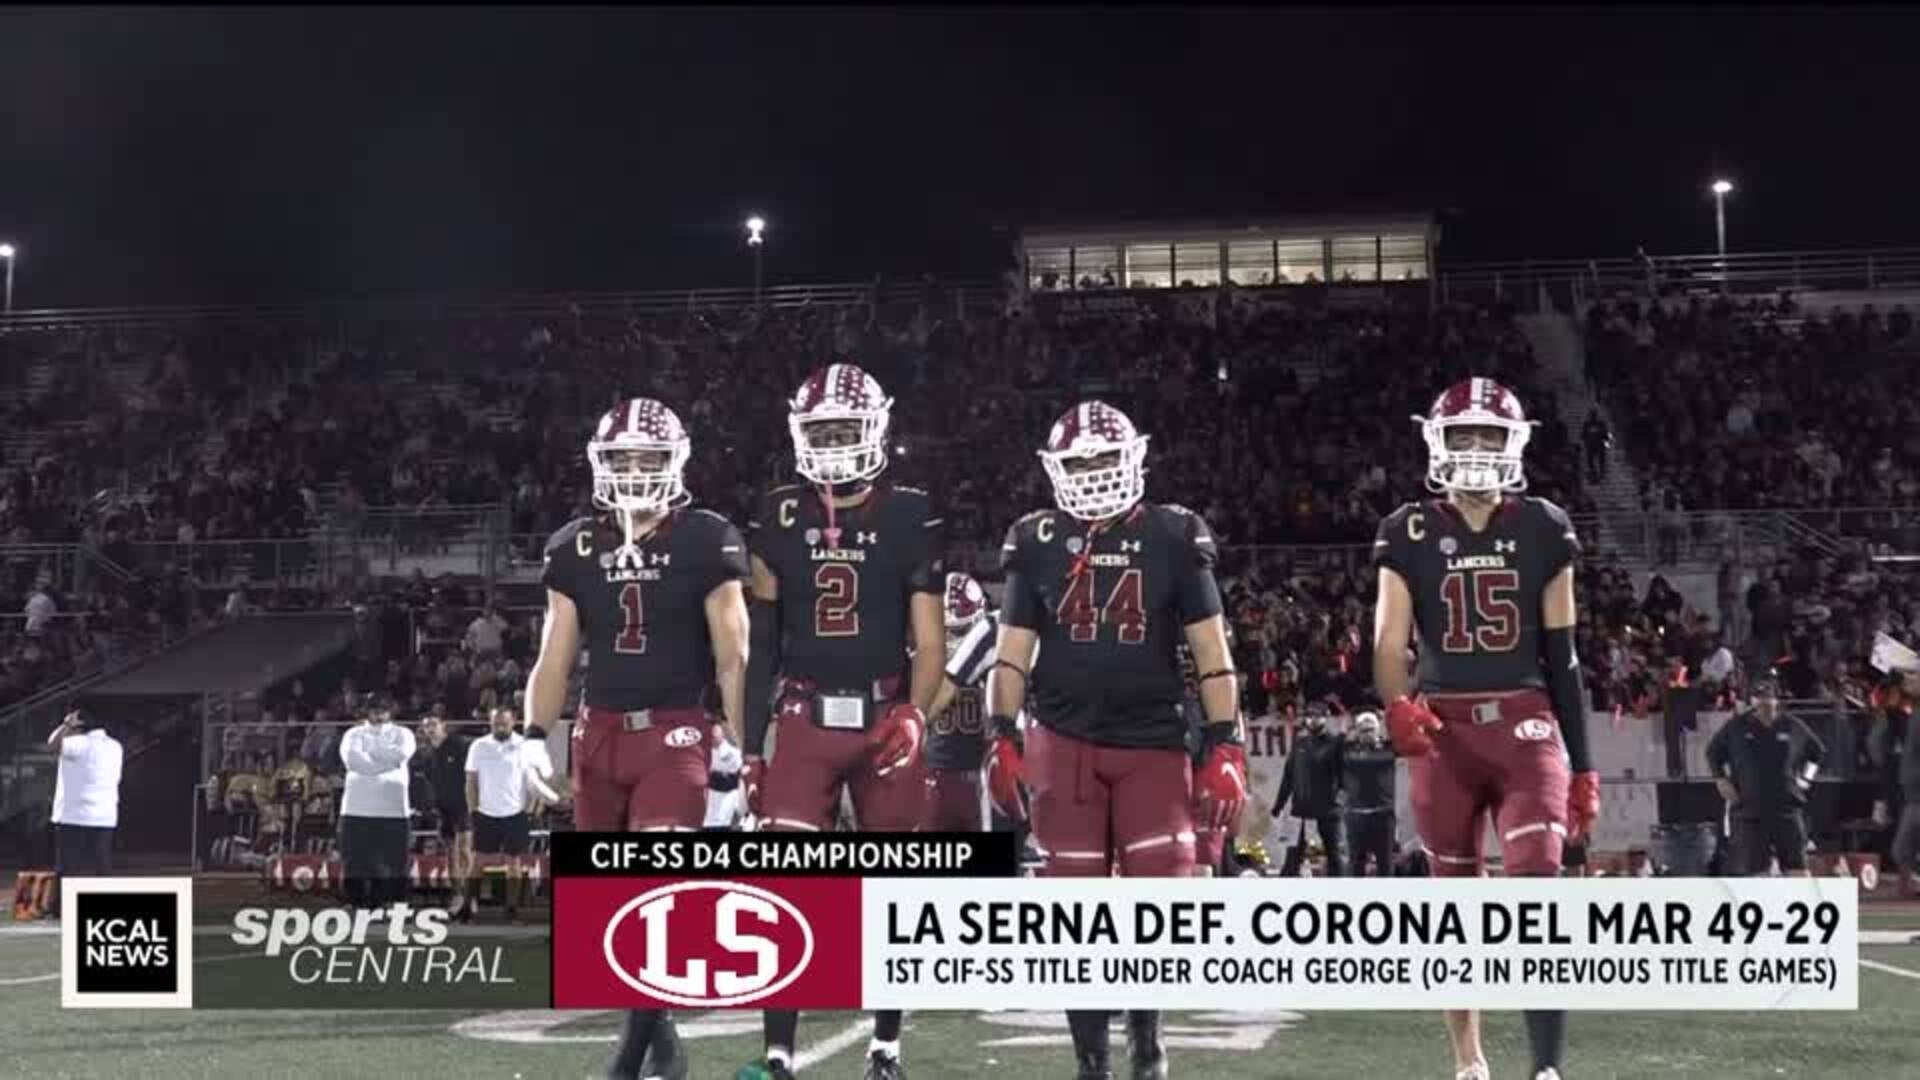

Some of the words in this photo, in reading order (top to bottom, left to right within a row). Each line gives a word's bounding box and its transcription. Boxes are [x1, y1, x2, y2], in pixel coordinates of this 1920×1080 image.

[779, 499, 798, 527] C
[1037, 518, 1055, 542] C
[1408, 515, 1425, 540] C
[576, 531, 592, 556] C
[811, 549, 865, 562] LANCERS
[1447, 556, 1505, 570] LANCERS
[815, 563, 859, 637] 2
[1057, 569, 1146, 643] 44
[1440, 571, 1520, 653] 15
[615, 584, 647, 654] 1
